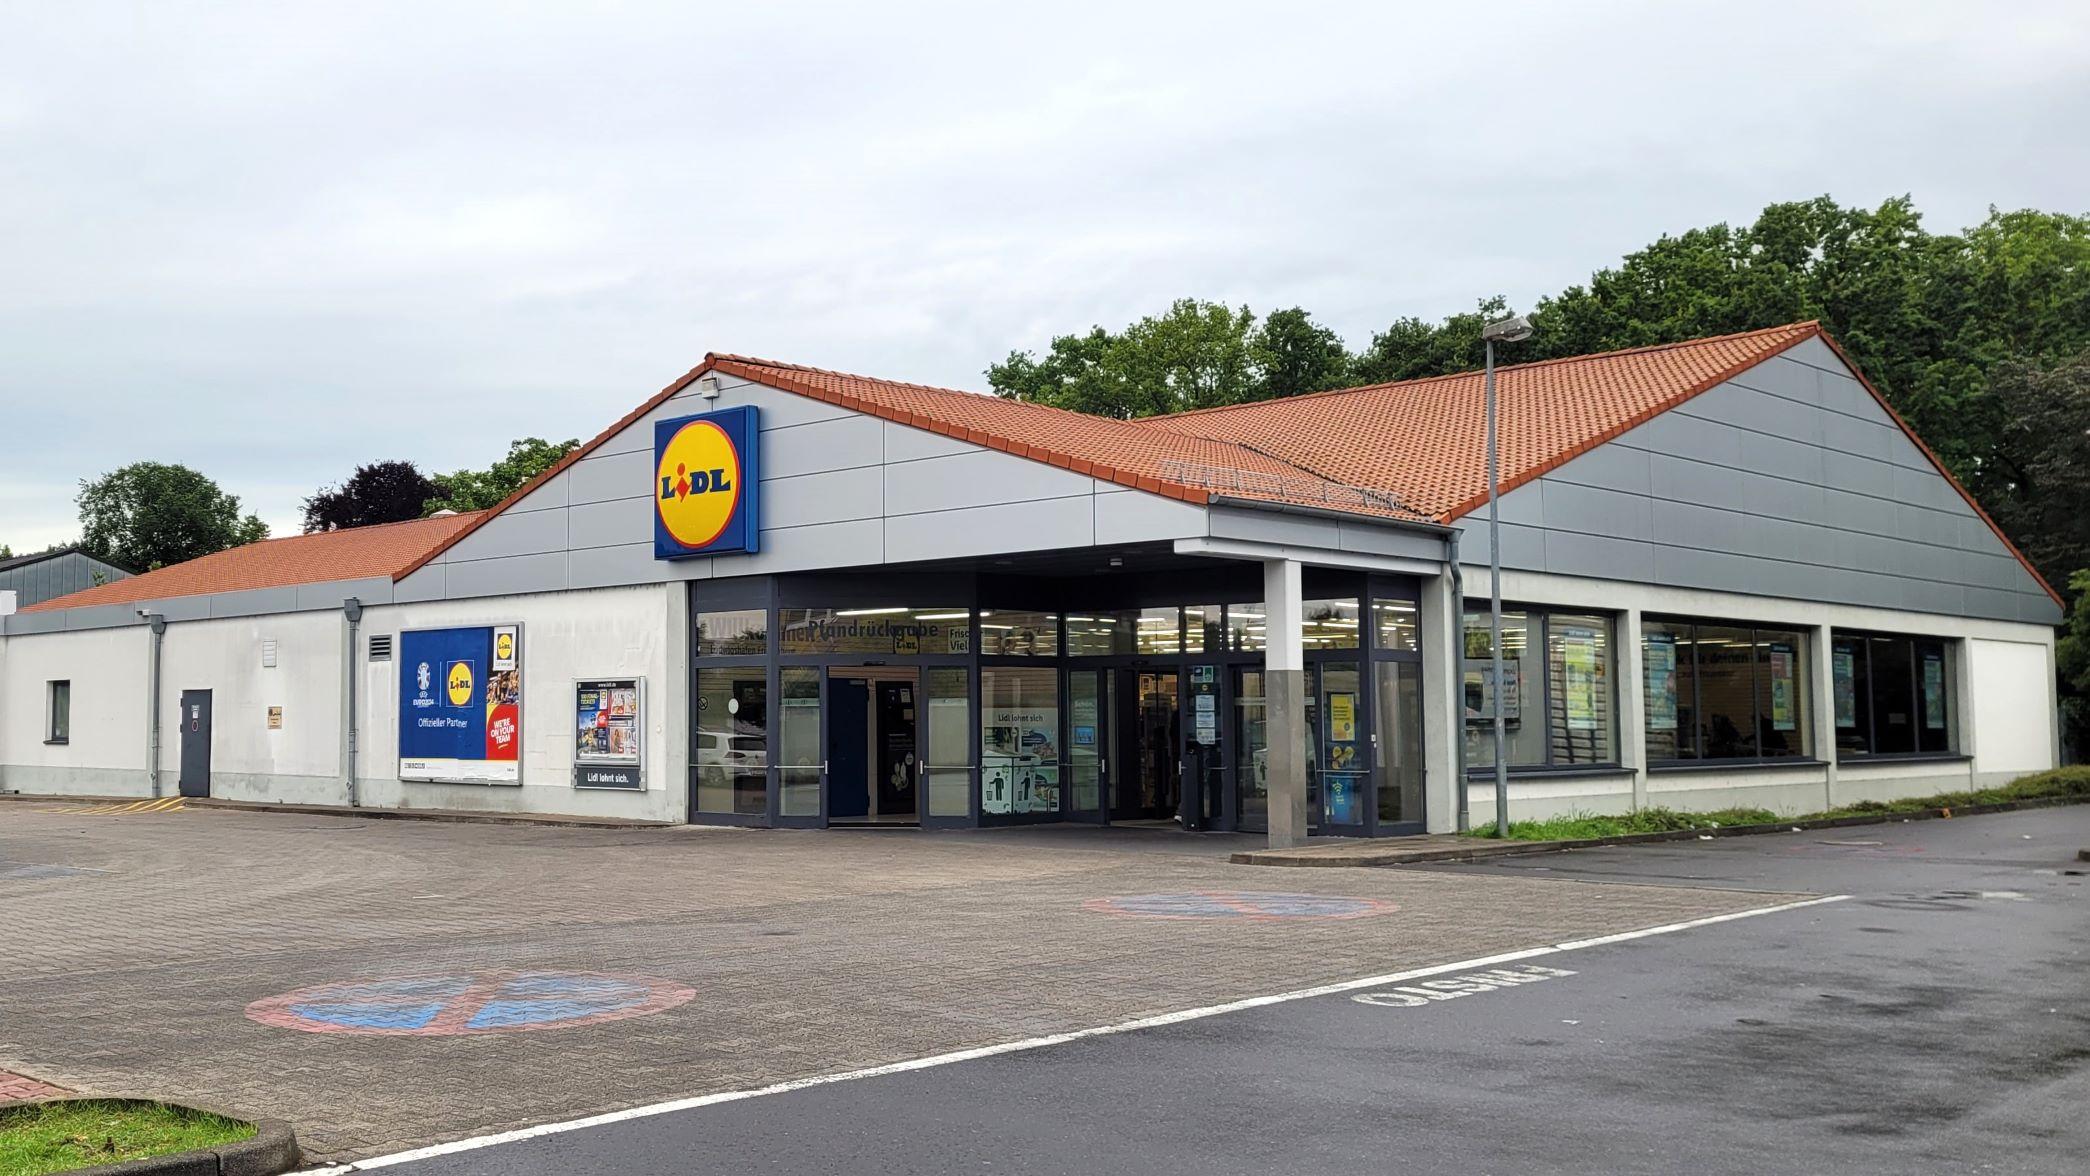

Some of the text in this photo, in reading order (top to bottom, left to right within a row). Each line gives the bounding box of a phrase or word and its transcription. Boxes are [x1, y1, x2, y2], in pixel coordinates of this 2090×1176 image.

[418, 717, 468, 728] Offizieller Partner
[998, 714, 1010, 722] Lidl
[1011, 714, 1028, 722] lohnt
[490, 725, 515, 738] ON YOUR
[495, 734, 511, 744] TEAM
[587, 773, 599, 782] Lidl
[599, 773, 614, 782] lohnt
